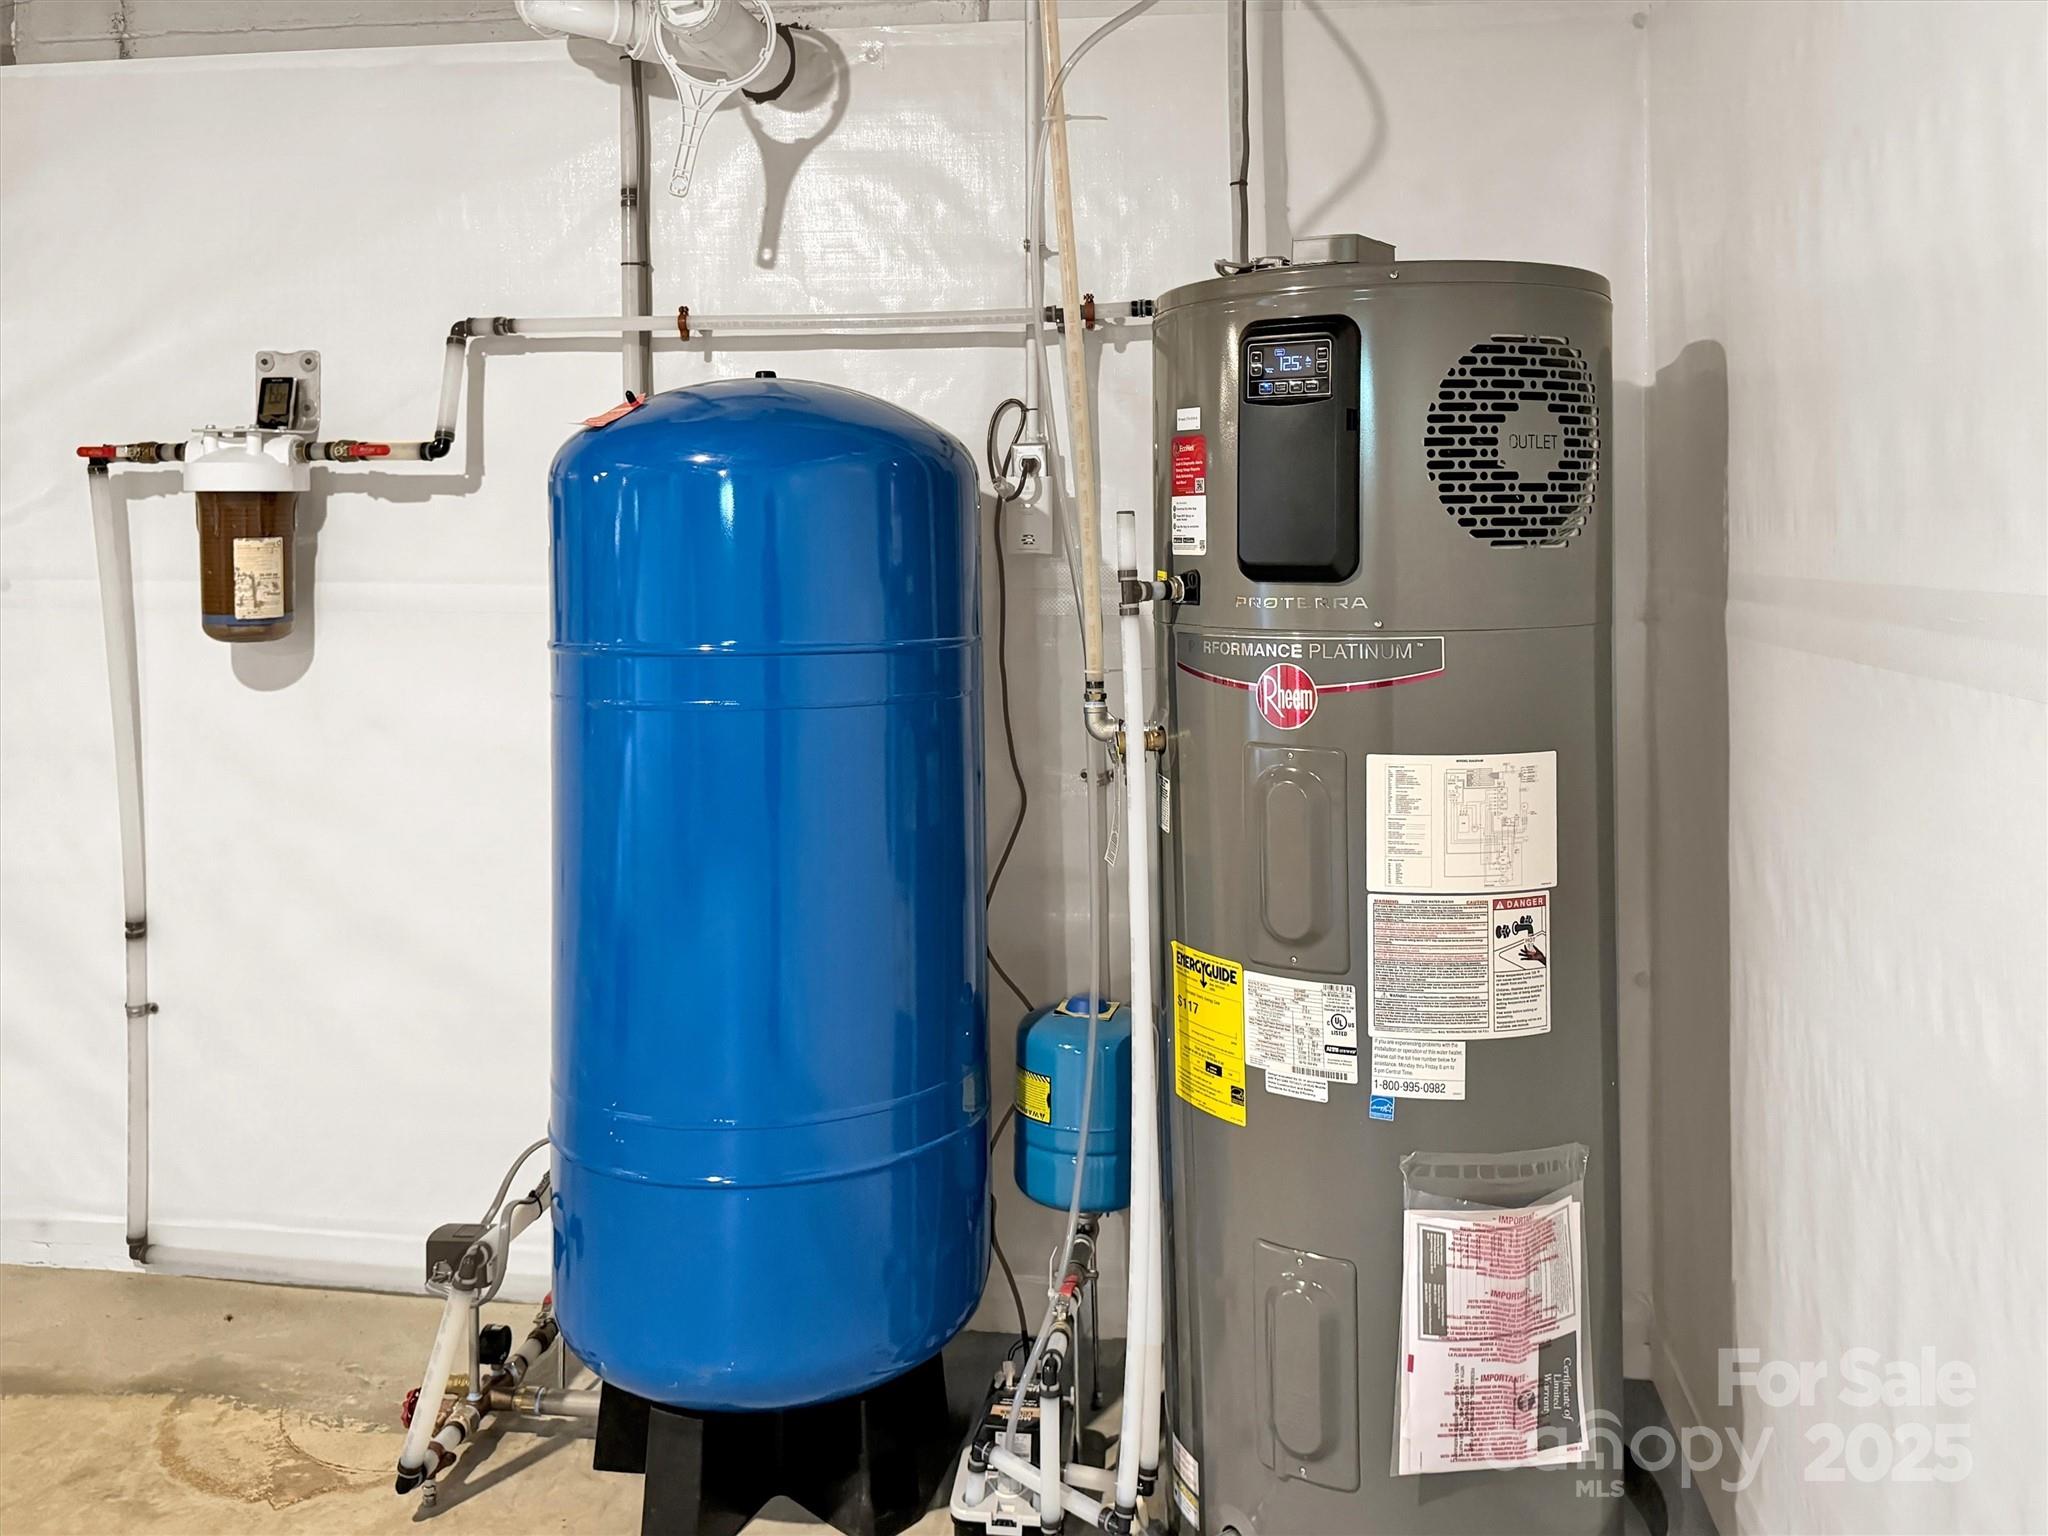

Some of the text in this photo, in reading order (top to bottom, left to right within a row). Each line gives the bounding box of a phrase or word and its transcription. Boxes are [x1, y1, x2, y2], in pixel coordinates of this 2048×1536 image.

[1509, 433, 1558, 449] OUTLET
[1235, 596, 1369, 609] PROTERRA
[1188, 639, 1303, 659] PRFORMANCE
[1263, 664, 1314, 717] Rheem
[1506, 897, 1544, 908] DANGER
[1177, 994, 1199, 1014] $117
[1374, 1079, 1446, 1094] 1-800-995-0982
[1553, 1373, 1562, 1410] Limited
[1562, 1357, 1574, 1421] Certificate of
